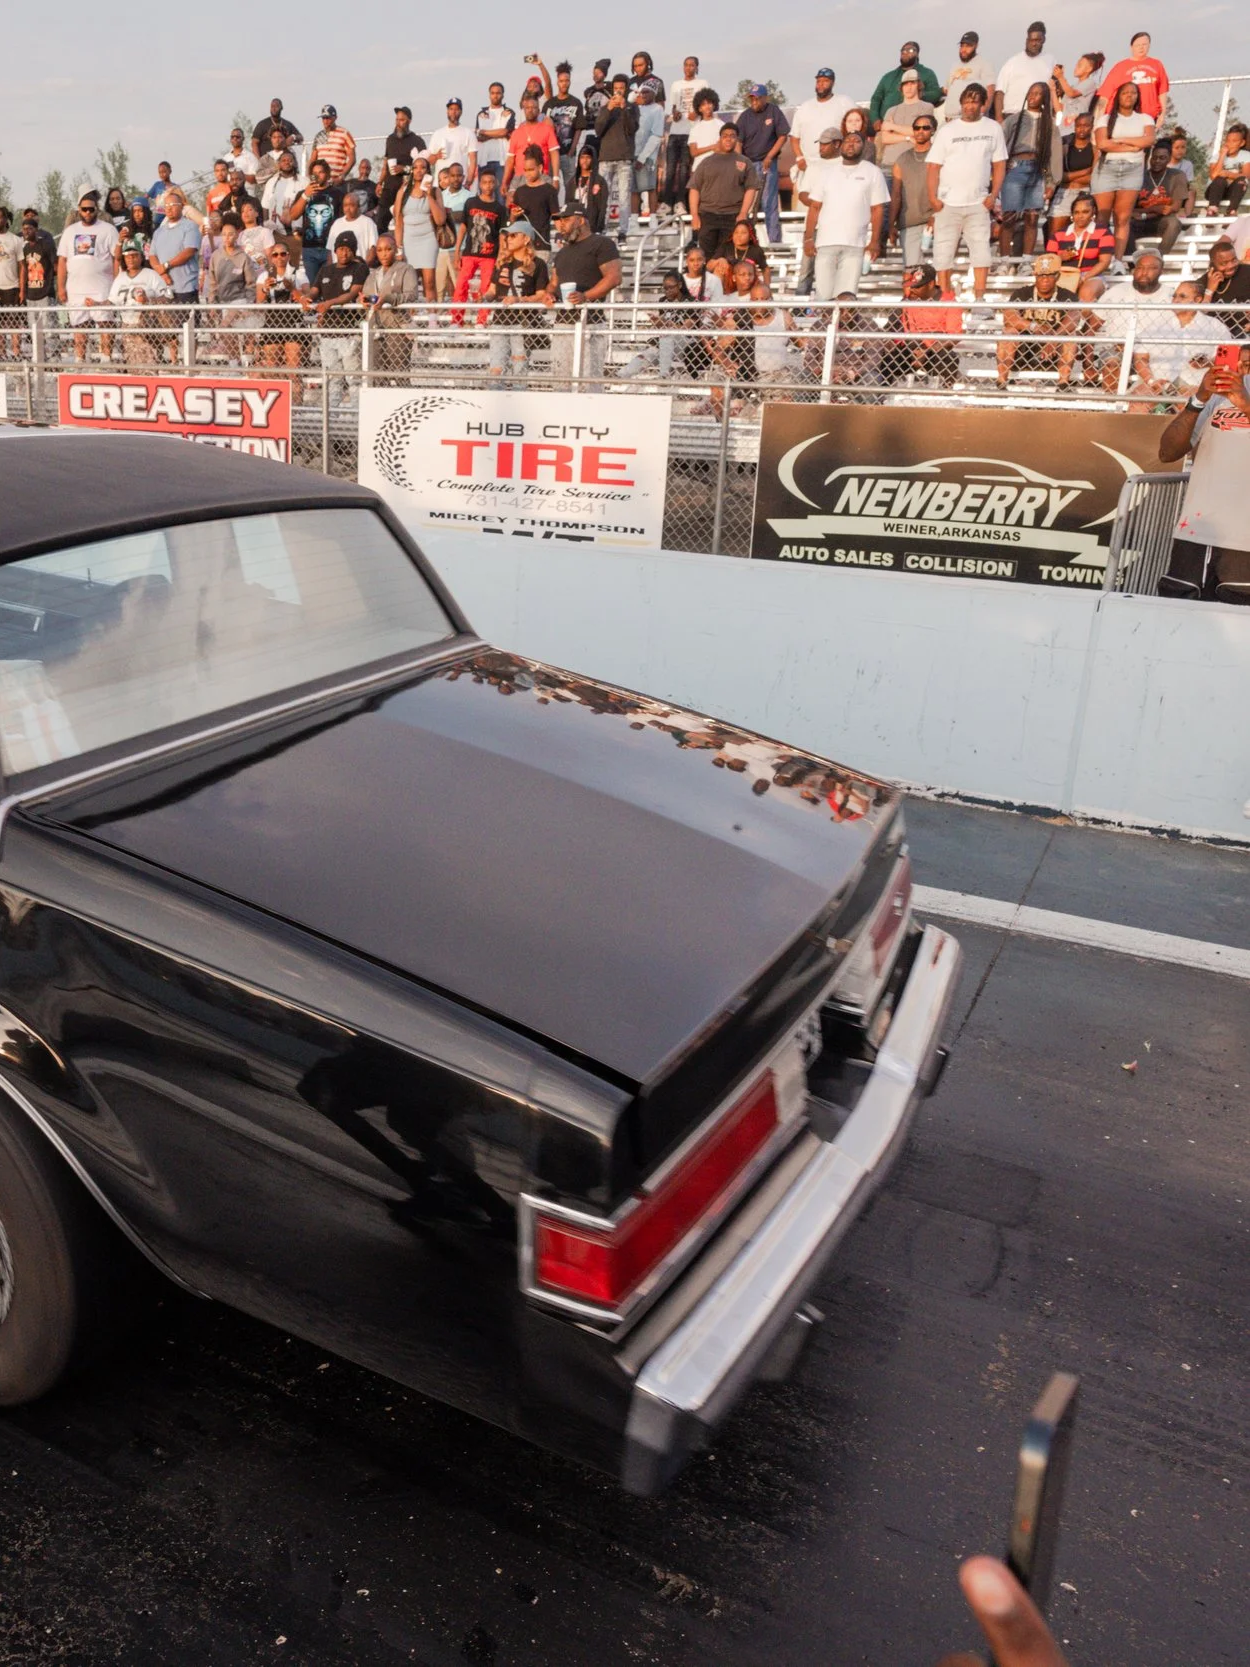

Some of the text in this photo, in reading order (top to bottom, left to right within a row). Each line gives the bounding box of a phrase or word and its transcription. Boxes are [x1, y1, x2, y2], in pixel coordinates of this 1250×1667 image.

[67, 382, 281, 429] CREASEY
[465, 421, 611, 441] HUB CITY
[440, 439, 638, 487] TIRE
[463, 492, 607, 516] 731-427-8541
[523, 484, 557, 497] Tire
[561, 487, 632, 502] Service
[832, 477, 1083, 528] NEWBERRY
[428, 511, 508, 523] MICKEY
[513, 517, 646, 535] THOMPSON
[778, 544, 830, 562] AUTO
[833, 548, 895, 568] SALES
[904, 553, 1014, 577] COLLISION
